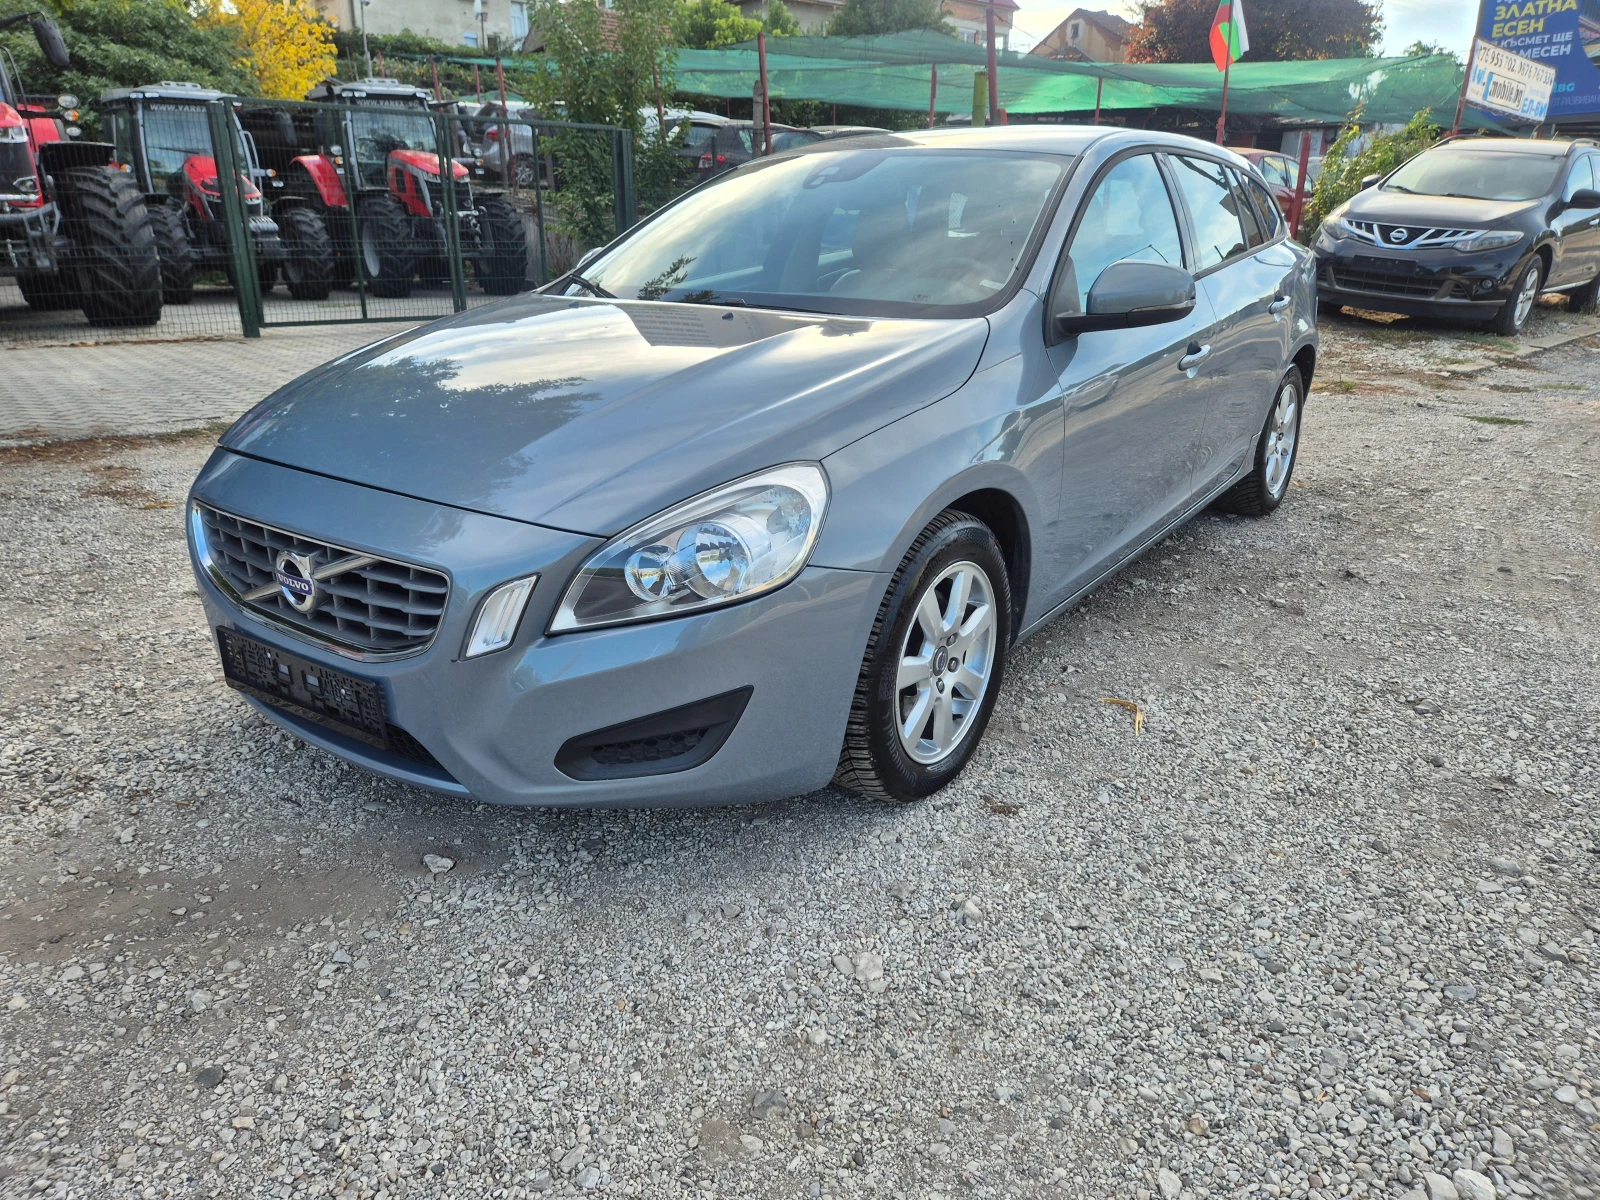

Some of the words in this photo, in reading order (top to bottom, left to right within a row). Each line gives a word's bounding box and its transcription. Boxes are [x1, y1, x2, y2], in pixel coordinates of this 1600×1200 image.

[1494, 0, 1577, 20] ЗЛАТНА
[1492, 18, 1545, 38] ЕСЕН
[1501, 34, 1550, 48] КЪСМЕТ
[1552, 31, 1573, 43] ЩЕ
[1515, 44, 1572, 58] МЕСЕН
[277, 573, 309, 591] VOLVO
